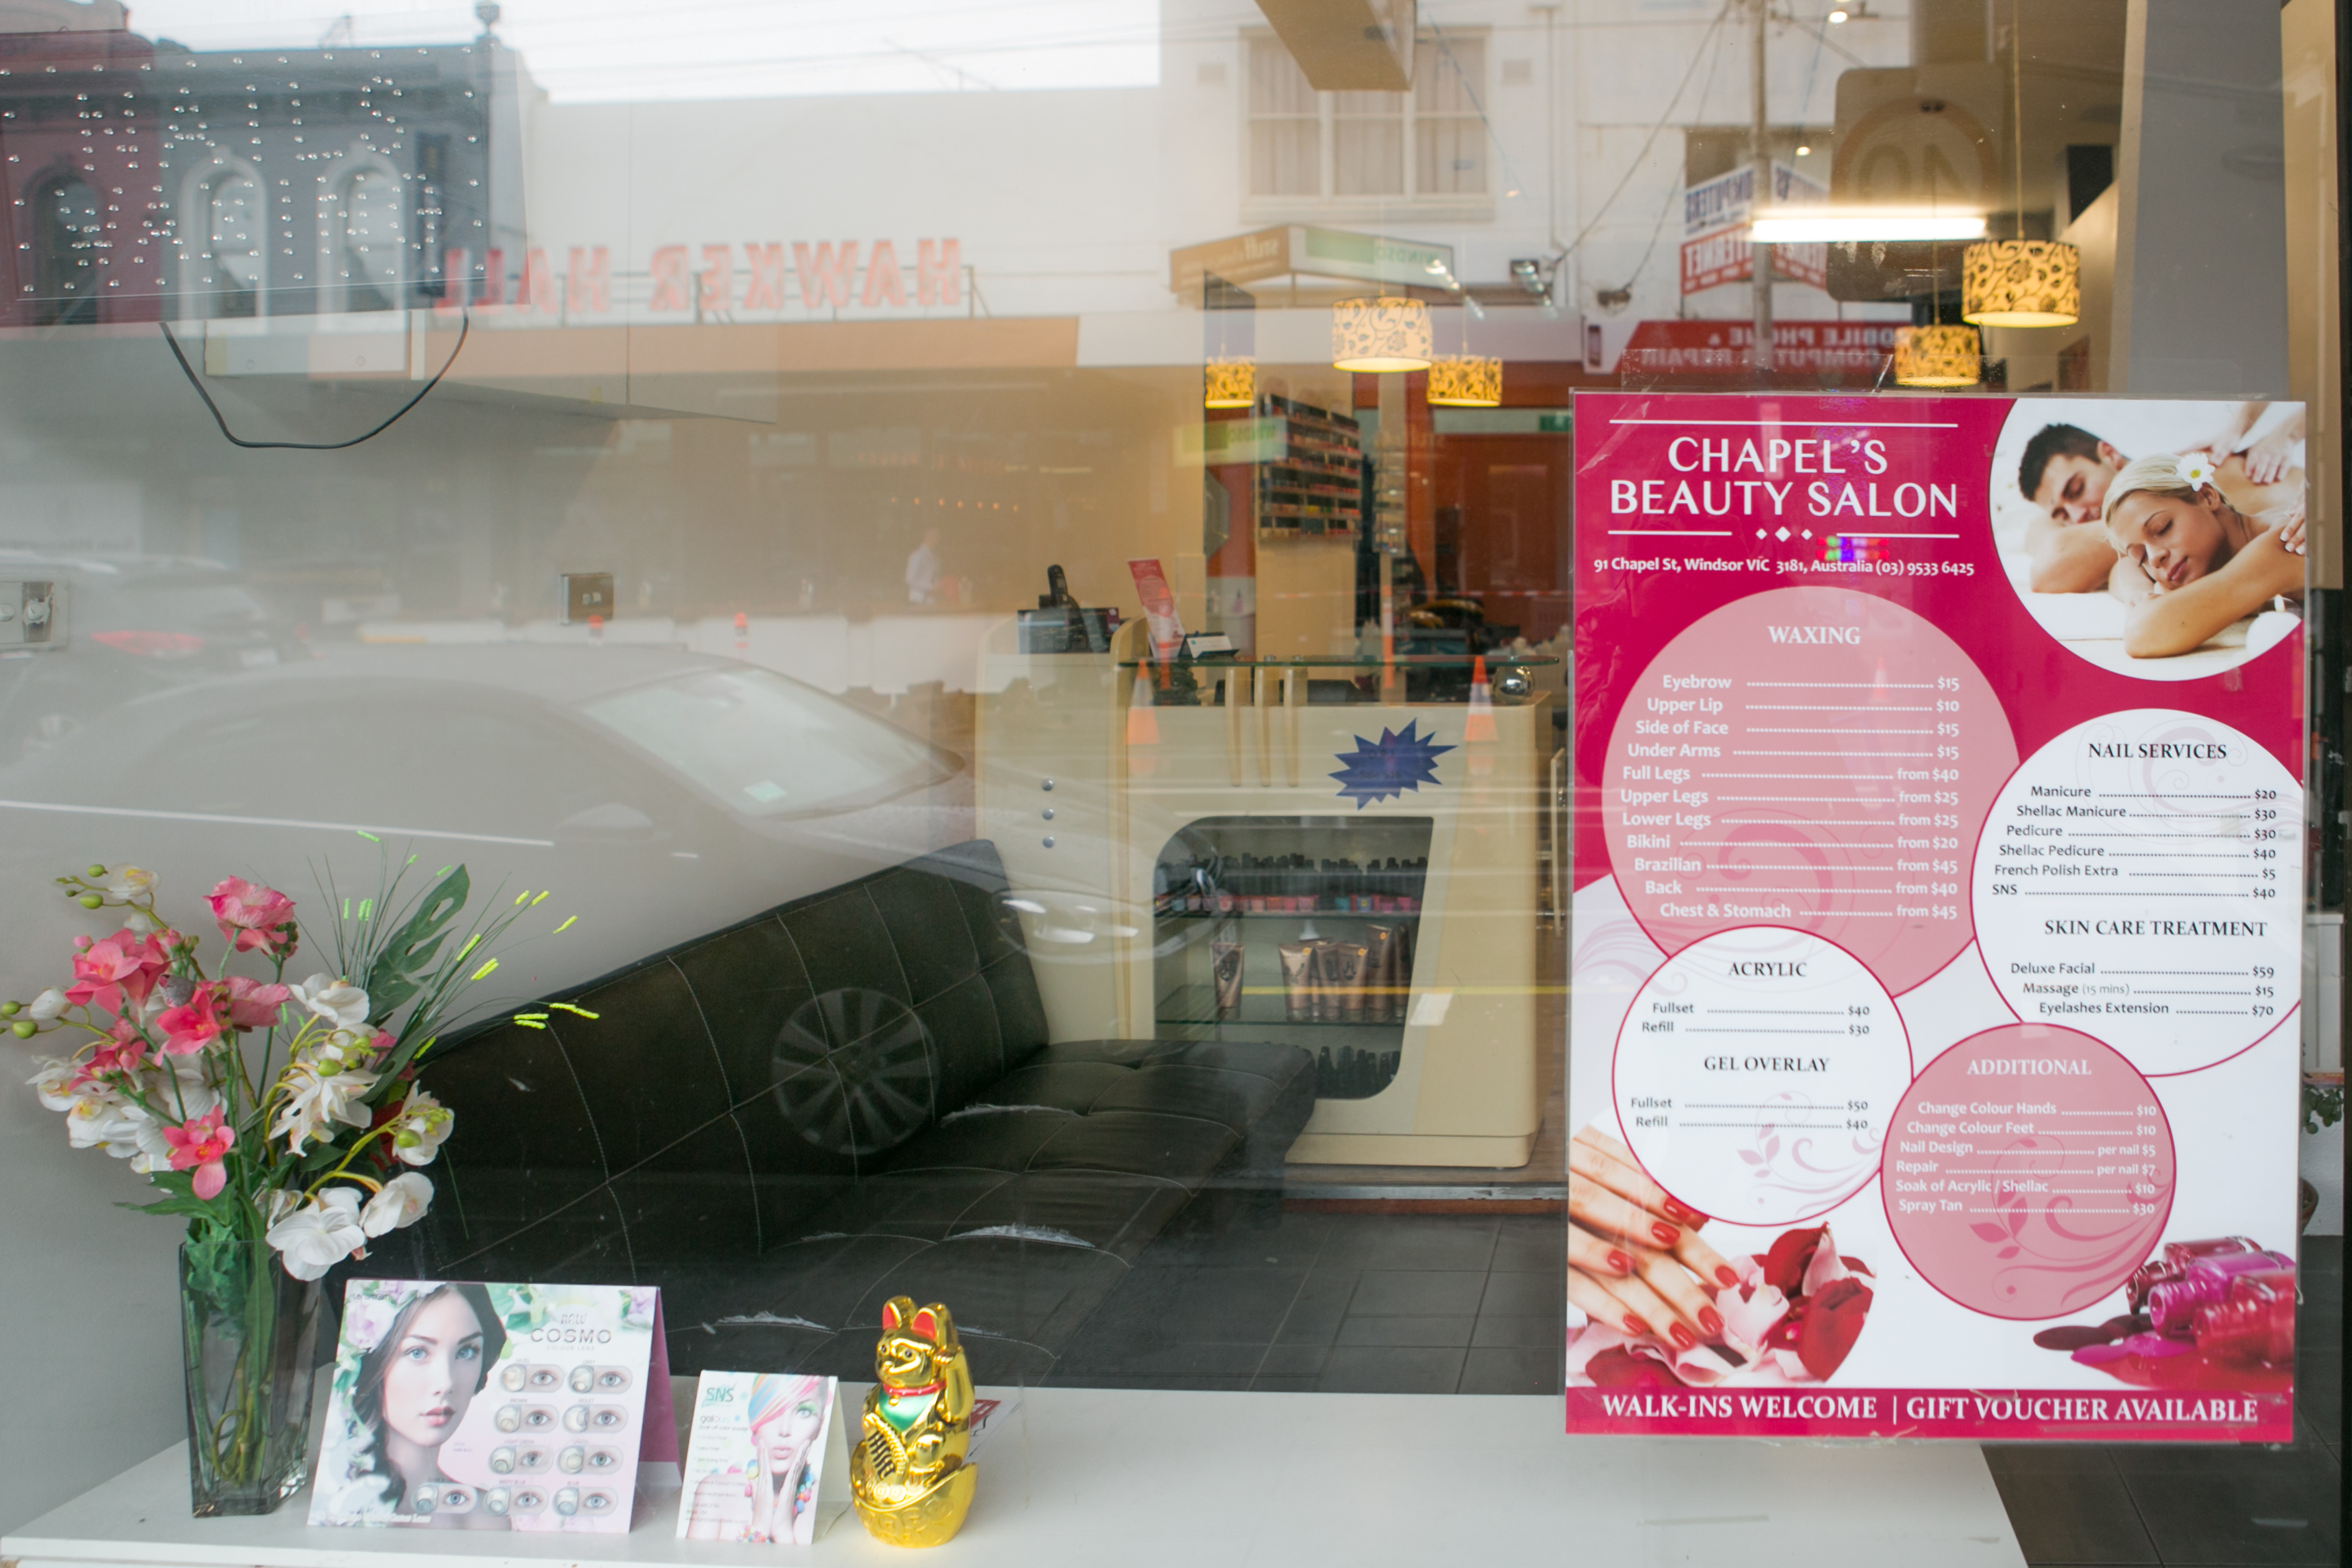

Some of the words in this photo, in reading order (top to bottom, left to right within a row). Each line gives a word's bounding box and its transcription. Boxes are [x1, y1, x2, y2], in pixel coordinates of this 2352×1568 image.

[1669, 437, 1887, 474] CHAPEL'S
[1611, 479, 1793, 515] BEAUTY
[1808, 481, 1956, 518] SALON
[1594, 559, 1608, 573] 91
[1611, 556, 1660, 574] Chapel
[1662, 557, 1682, 573] St,
[1683, 557, 1744, 571] Windsor
[1746, 559, 1770, 572] VIC
[1776, 559, 1808, 574] 3181,
[1810, 556, 1873, 572] Australia
[1875, 559, 1904, 576] (03)
[1906, 562, 1939, 576] 9533
[1941, 561, 1975, 576] 6425
[1768, 626, 1861, 644] WAXING
[1663, 674, 1732, 692] Eyebrow
[1937, 676, 1960, 692] $15
[1647, 697, 1696, 715] Upper
[1699, 697, 1723, 715] Lip
[1936, 699, 1960, 713] $10
[1635, 719, 1670, 734] Side
[1672, 719, 1690, 735] of
[1693, 720, 1729, 735] Face
[1937, 722, 1959, 738] $15
[1628, 742, 1676, 757] Under
[1679, 743, 1721, 758] Arms
[1937, 744, 1959, 761] $15
[2089, 743, 2133, 758] NAIL
[2138, 744, 2226, 759] SERVICES
[1623, 765, 1651, 780] Full
[1655, 766, 1691, 784] Legs
[1896, 767, 1929, 780] from
[1932, 767, 1959, 783] $40
[1620, 789, 1670, 807] Upper
[1673, 789, 1709, 807] Legs
[1898, 790, 1931, 803] from
[1934, 790, 1959, 806] $25
[2031, 786, 2091, 797] Manicure
[2254, 789, 2277, 800] $20
[1622, 812, 1672, 826] Lower
[1676, 812, 1711, 830] Legs
[1898, 813, 1931, 826] from
[1934, 813, 1959, 829] $25
[2017, 805, 2062, 817] Shellac
[2066, 805, 2126, 817] Manicure
[2254, 809, 2276, 822] $30
[1627, 833, 1671, 848] Bikini
[1897, 836, 1930, 849] from
[1932, 835, 1959, 850] $20
[2006, 825, 2062, 837] Pedicure
[2254, 828, 2276, 841] $30
[1999, 844, 2044, 856] Shellac
[2049, 845, 2105, 856] Pedicure
[2253, 848, 2276, 860] $40
[1634, 857, 1701, 871] Brazilian
[1896, 858, 1929, 871] from
[1932, 858, 1958, 874] $45
[1995, 864, 2038, 876] French
[2042, 864, 2080, 876] Polish
[2085, 865, 2118, 876] Extra
[2262, 868, 2276, 880] $5
[1645, 879, 1682, 894] Back
[1895, 881, 1928, 894] from
[1931, 881, 1958, 897] $40
[1992, 884, 2017, 895] SNS
[2253, 887, 2276, 899] $40
[1660, 902, 1704, 917] Chest
[1706, 903, 1720, 917] &
[1723, 903, 1791, 918] Stomach
[1896, 904, 1929, 917] from
[1932, 904, 1957, 920] $45
[2045, 920, 2090, 935] SKIN
[2096, 920, 2145, 935] CARE
[2150, 921, 2267, 937] TREATMENT
[1729, 962, 1807, 976] ACRYLIC
[2011, 962, 2055, 974] Deluxe
[2059, 962, 2095, 974] Facial
[2253, 966, 2274, 978] $59
[2023, 983, 2079, 997] Massage
[2082, 984, 2097, 996] (15
[2099, 983, 2129, 996] mins)
[2255, 985, 2274, 997] $15
[1653, 1002, 1694, 1013] Fullset
[1848, 1006, 1870, 1017] $40
[2039, 1002, 2102, 1016] Eyelashes
[2106, 1002, 2169, 1014] Extension
[2252, 1005, 2274, 1017] $70
[1642, 1021, 1674, 1032] Refill
[1849, 1024, 1870, 1035] $30
[1704, 1057, 1739, 1071] GEL
[1745, 1057, 1829, 1072] OVERLAY
[1967, 1059, 2092, 1075] ADDITIONAL
[1631, 1097, 1671, 1108] Fullset
[1847, 1100, 1868, 1111] $50
[1918, 1101, 1967, 1118] Change
[1970, 1101, 2014, 1114] Colour
[2016, 1101, 2057, 1114] Hands
[2136, 1104, 2157, 1117] $10
[1636, 1116, 1668, 1127] Refill
[1846, 1119, 1868, 1130] $40
[1906, 1121, 1956, 1137] Change
[1959, 1121, 2003, 1134] Colour
[2006, 1122, 2034, 1134] Feet
[2136, 1124, 2156, 1137] $10
[1900, 1140, 1926, 1153] Nail
[1928, 1140, 1973, 1157] Design
[2098, 1146, 2117, 1158] per
[2119, 1144, 2139, 1155] nail
[2142, 1144, 2156, 1157] $5
[1896, 1160, 1939, 1176] Repair
[2097, 1166, 2116, 1177] per
[2118, 1163, 2139, 1175] nail
[2141, 1163, 2156, 1176] $7
[1896, 1179, 1927, 1192] Soak
[1930, 1179, 1945, 1192] of
[1947, 1179, 1991, 1195] Acrylic
[1994, 1178, 2000, 1194] /
[2002, 1180, 2049, 1193] Shellac
[2135, 1182, 2156, 1195] $10
[1899, 1198, 1936, 1214] Spray
[1939, 1199, 1963, 1211] Tan
[2133, 1203, 2155, 1216] $30
[531, 1328, 612, 1344] COSMO
[706, 1387, 734, 1402] SNS
[1601, 1395, 1732, 1418] WALK-INS
[1739, 1395, 1877, 1418] WELCOME
[1906, 1397, 1969, 1419] GIFT
[1974, 1394, 2109, 1420] VOUCHER
[2115, 1398, 2258, 1422] AVAILABLE
